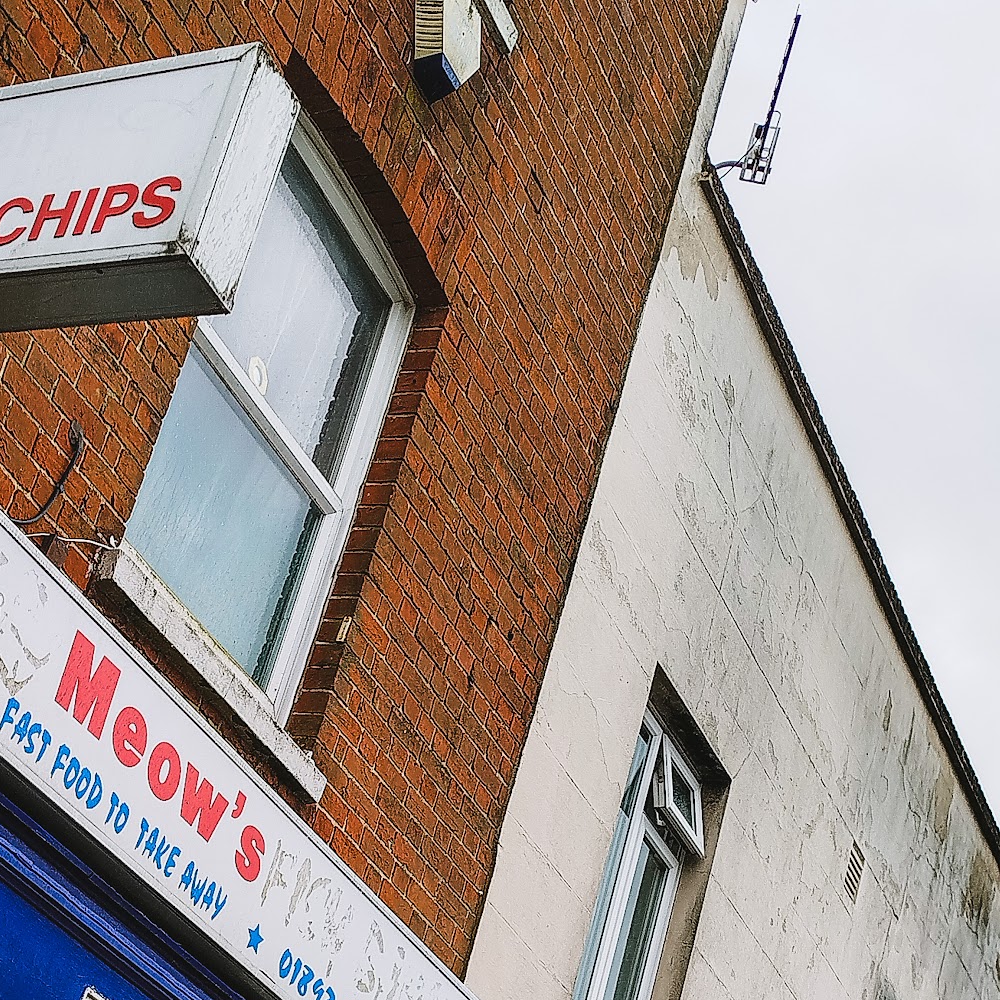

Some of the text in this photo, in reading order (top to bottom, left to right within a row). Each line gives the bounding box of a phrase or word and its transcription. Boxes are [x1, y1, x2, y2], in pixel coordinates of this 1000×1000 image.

[50, 743, 103, 809] FOOD
[105, 791, 130, 834] TO
[135, 817, 182, 878] TAKE
[178, 860, 228, 920] AWAY
[54, 629, 267, 883] Meow's
